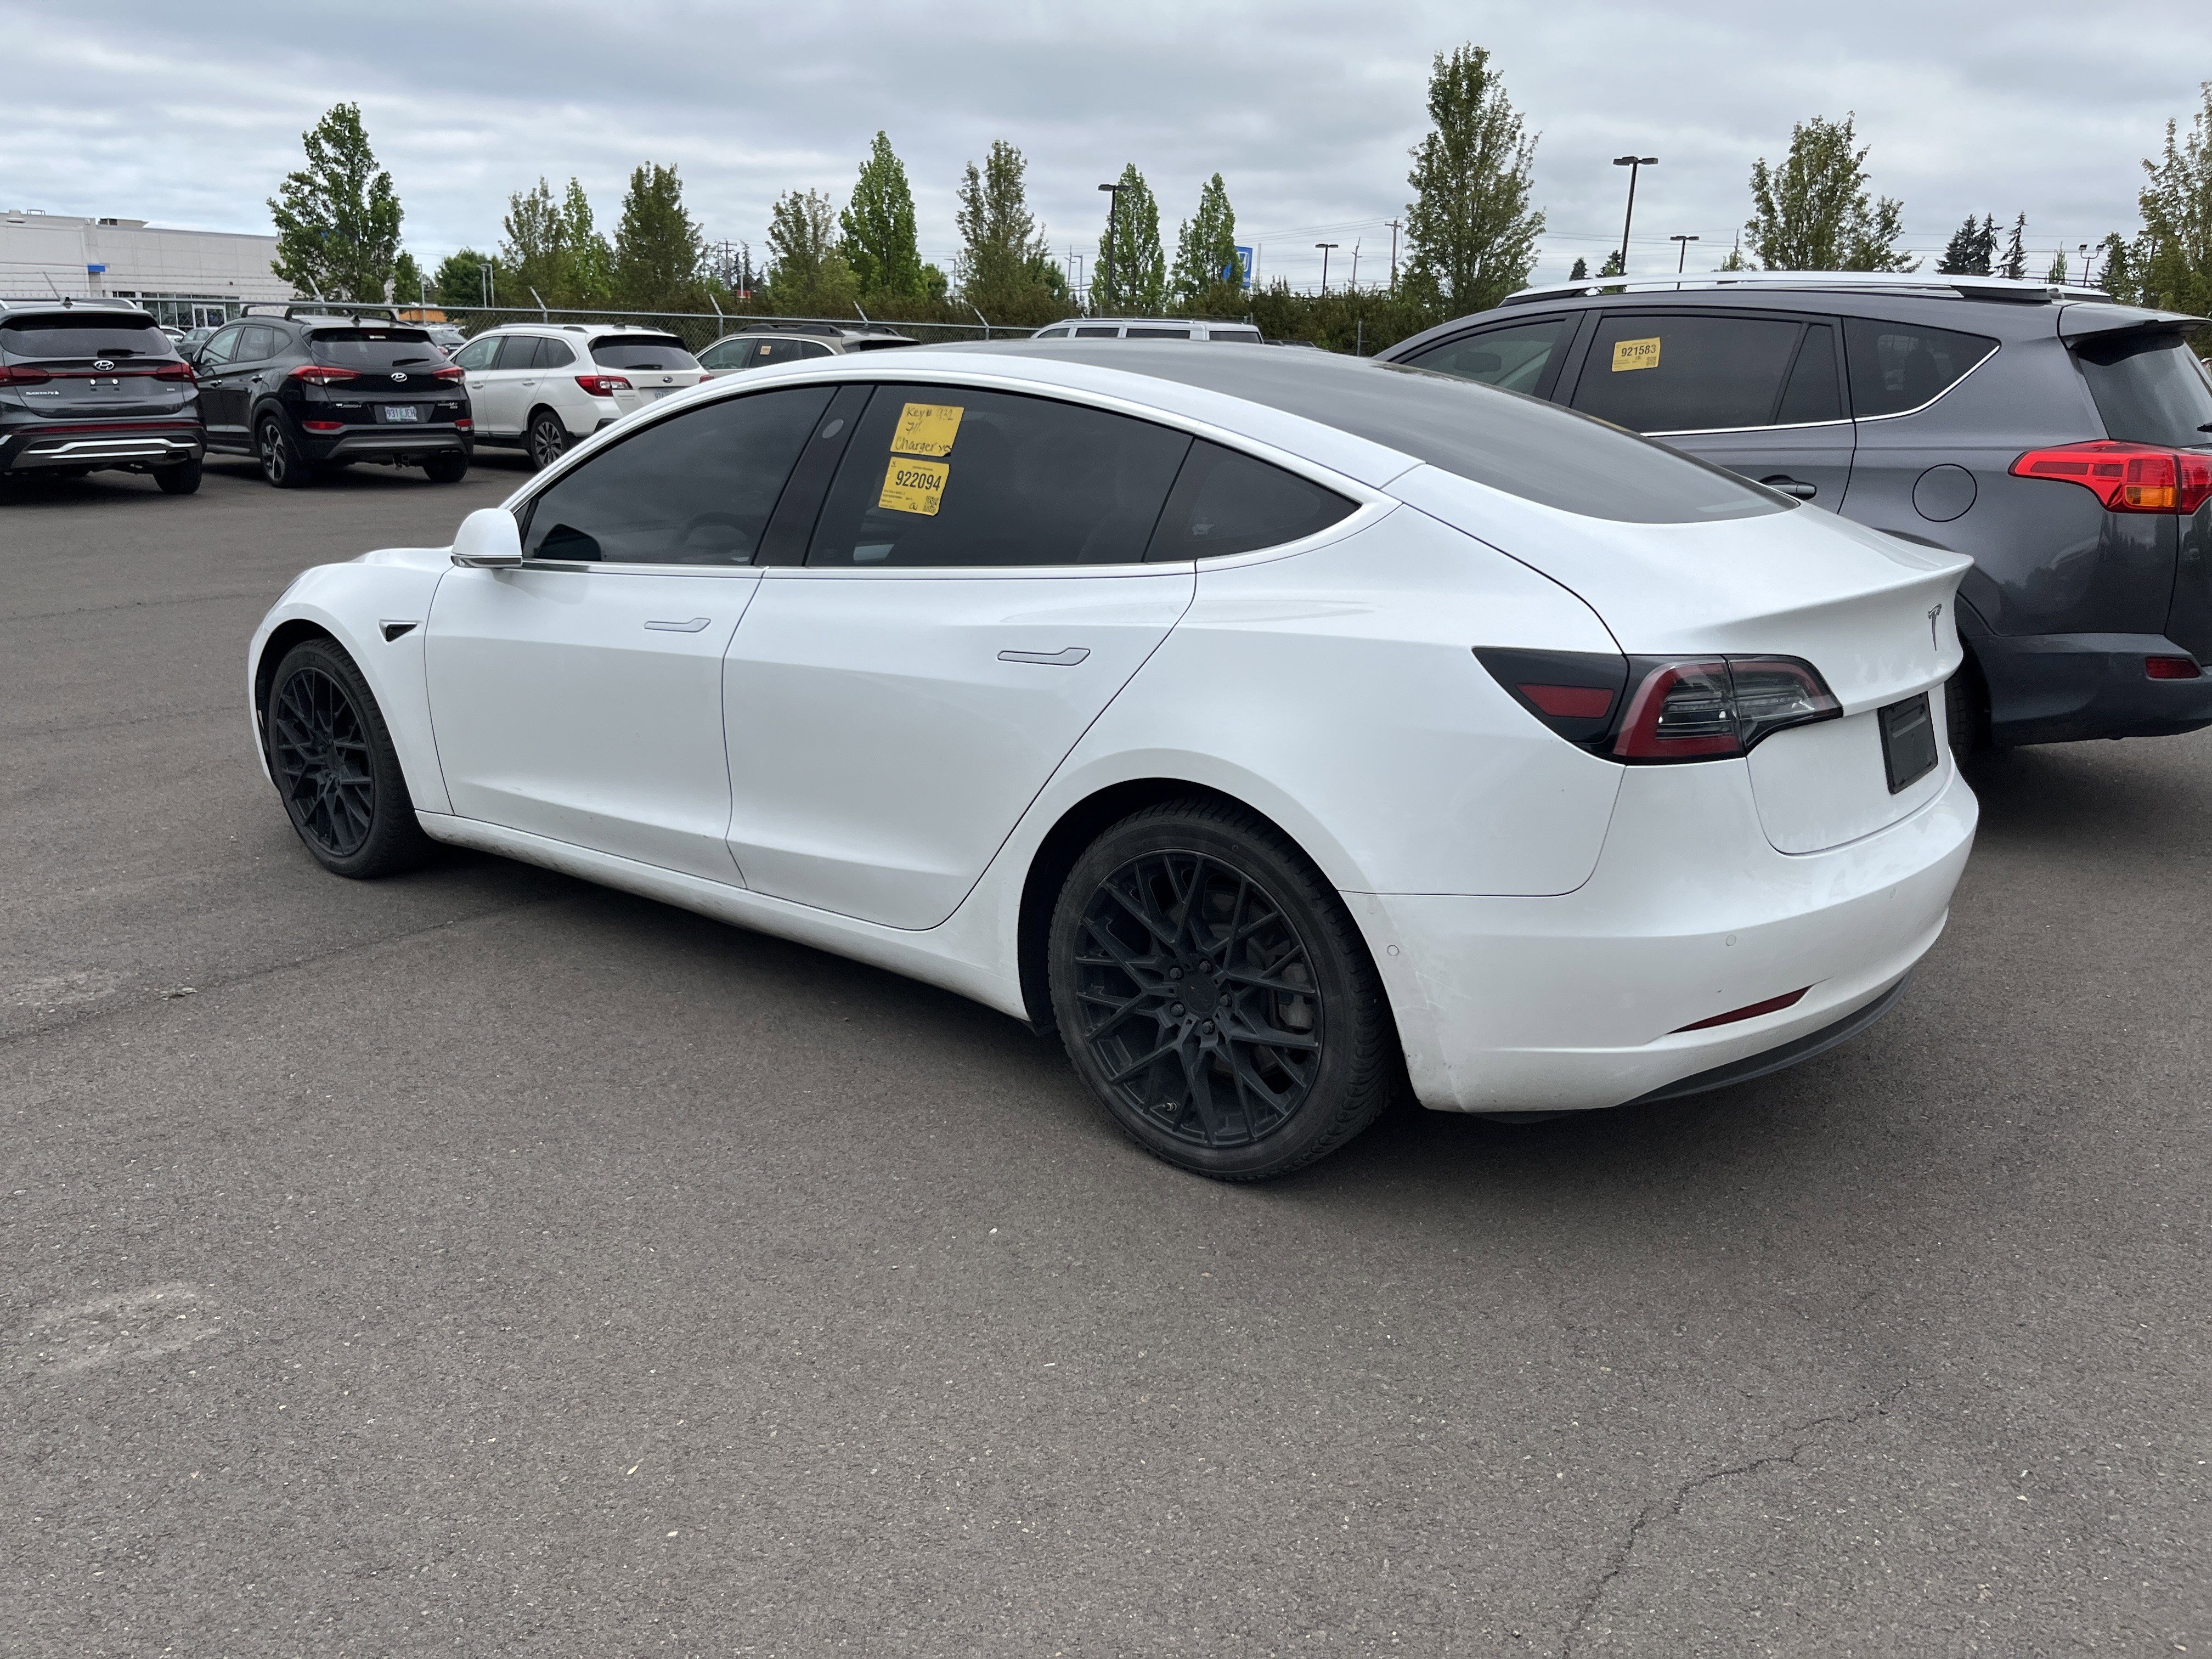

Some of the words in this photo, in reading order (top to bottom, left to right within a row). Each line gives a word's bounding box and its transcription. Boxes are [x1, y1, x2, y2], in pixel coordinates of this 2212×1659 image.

[1621, 344, 1656, 357] 921583
[386, 409, 398, 418] 931
[895, 437, 937, 453] Charger
[895, 470, 941, 492] 922094
